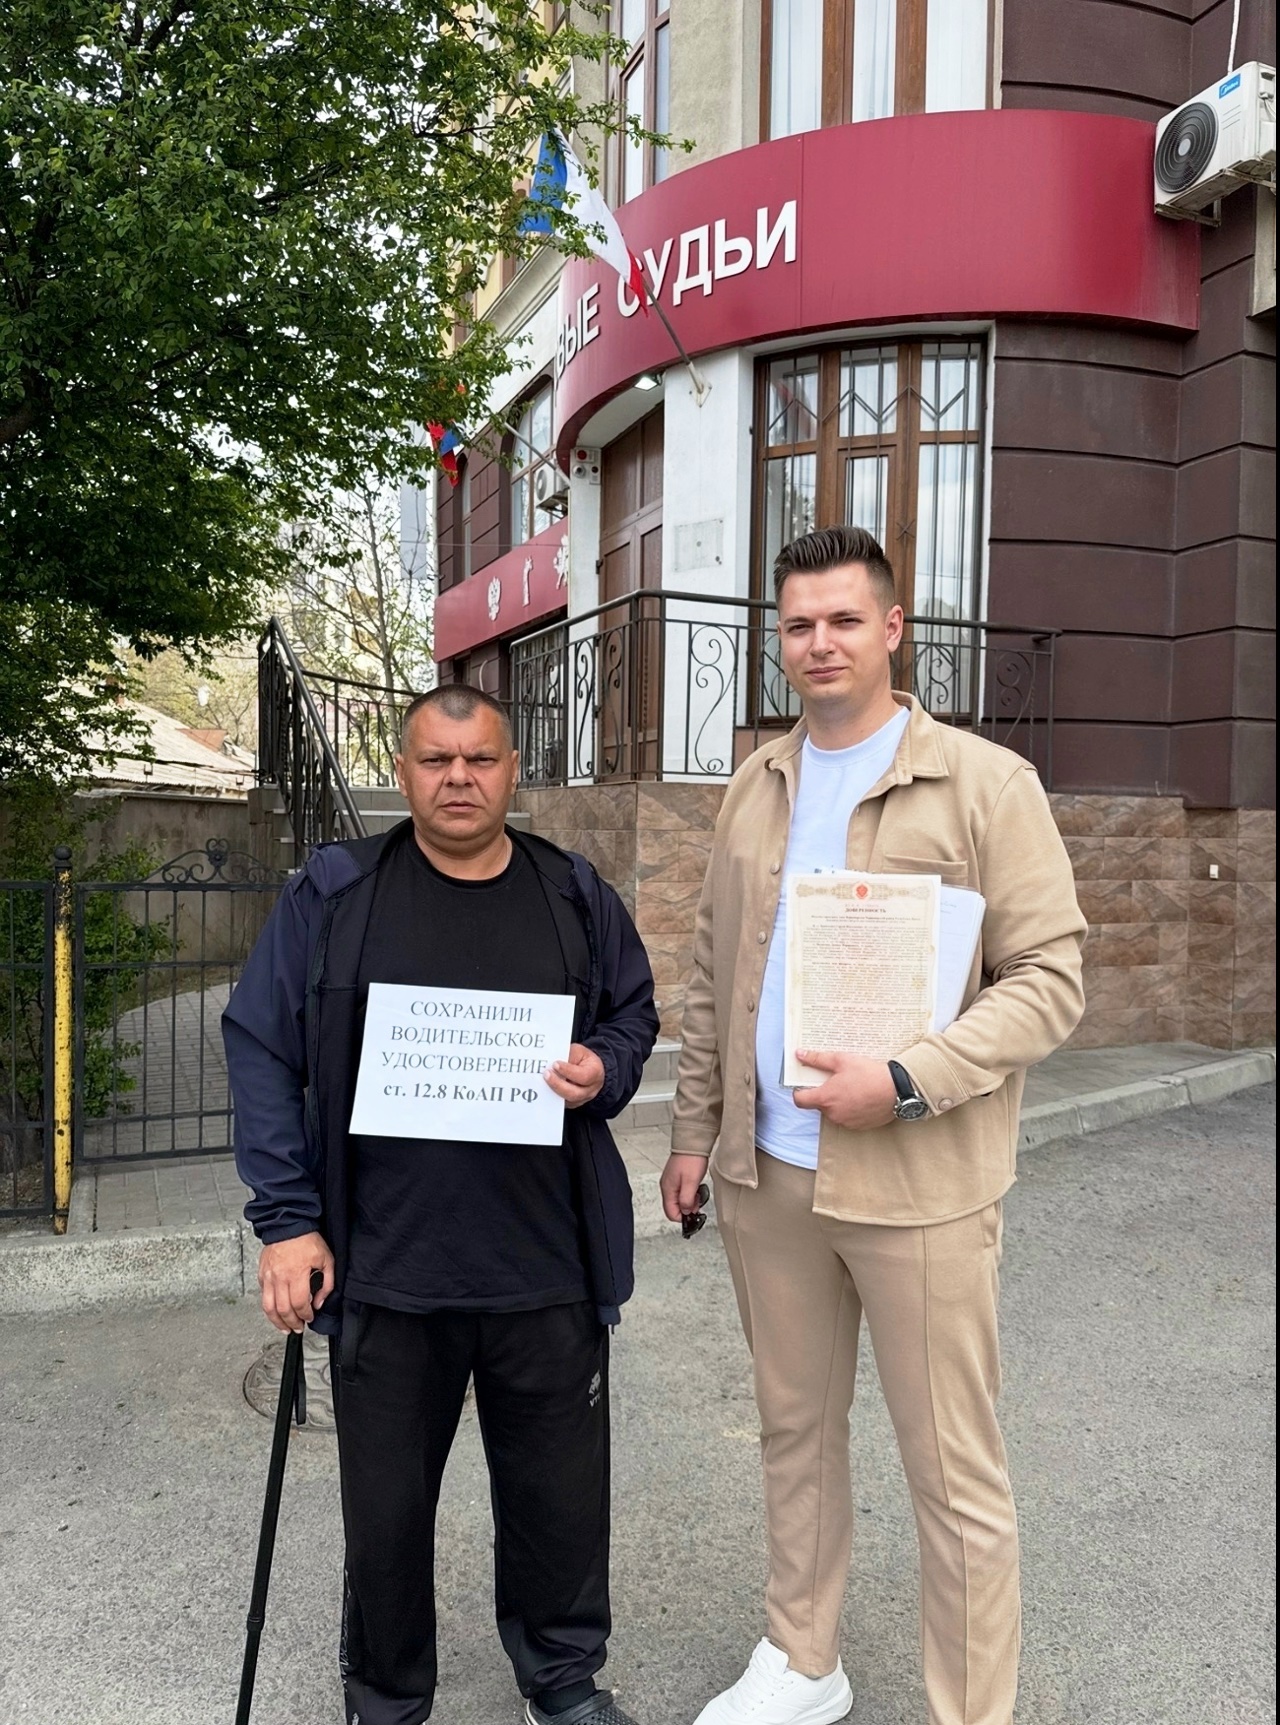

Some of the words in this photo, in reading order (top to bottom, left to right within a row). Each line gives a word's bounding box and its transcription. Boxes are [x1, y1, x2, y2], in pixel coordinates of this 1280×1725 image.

[554, 282, 600, 392] ВЫЕ
[617, 200, 797, 317] СУДЬИ
[410, 1000, 532, 1022] СОХРАНИЛИ
[390, 1025, 546, 1049] ВОДИТЕЛЬСКОЕ
[381, 1051, 548, 1074] УДОСТОВЕРЕНИЕ
[383, 1084, 406, 1098] ст.
[413, 1083, 447, 1099] 12.8
[453, 1085, 503, 1102] КоАП
[510, 1087, 539, 1103] РФ
